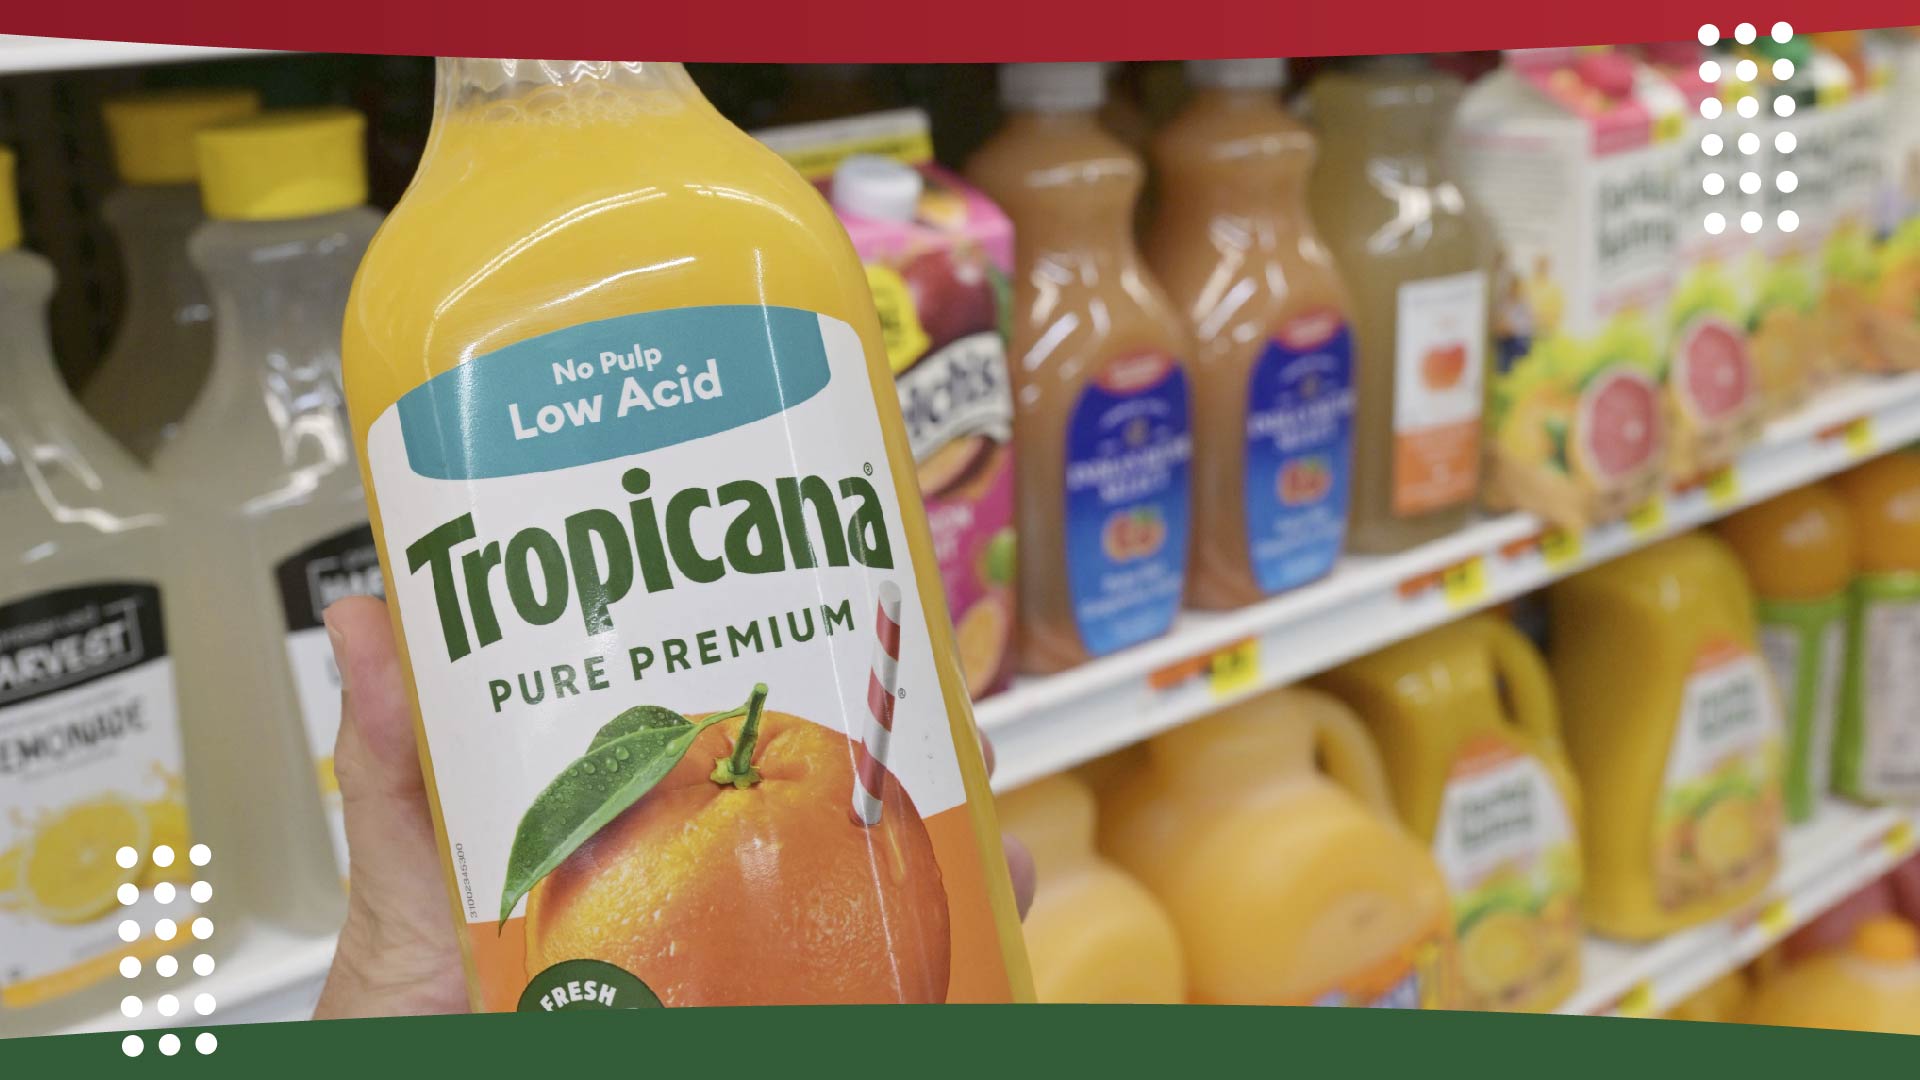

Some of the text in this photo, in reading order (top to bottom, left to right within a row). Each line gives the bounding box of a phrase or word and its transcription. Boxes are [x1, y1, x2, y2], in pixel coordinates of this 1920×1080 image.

[508, 358, 724, 441] Low Acid
[552, 343, 663, 386] No Pulp
[405, 466, 895, 663] Tropicana
[0, 618, 126, 692] ARVEST
[488, 598, 856, 713] PURE PREMIUM
[0, 697, 146, 774] EMONADE
[539, 979, 618, 1012] FRESH
